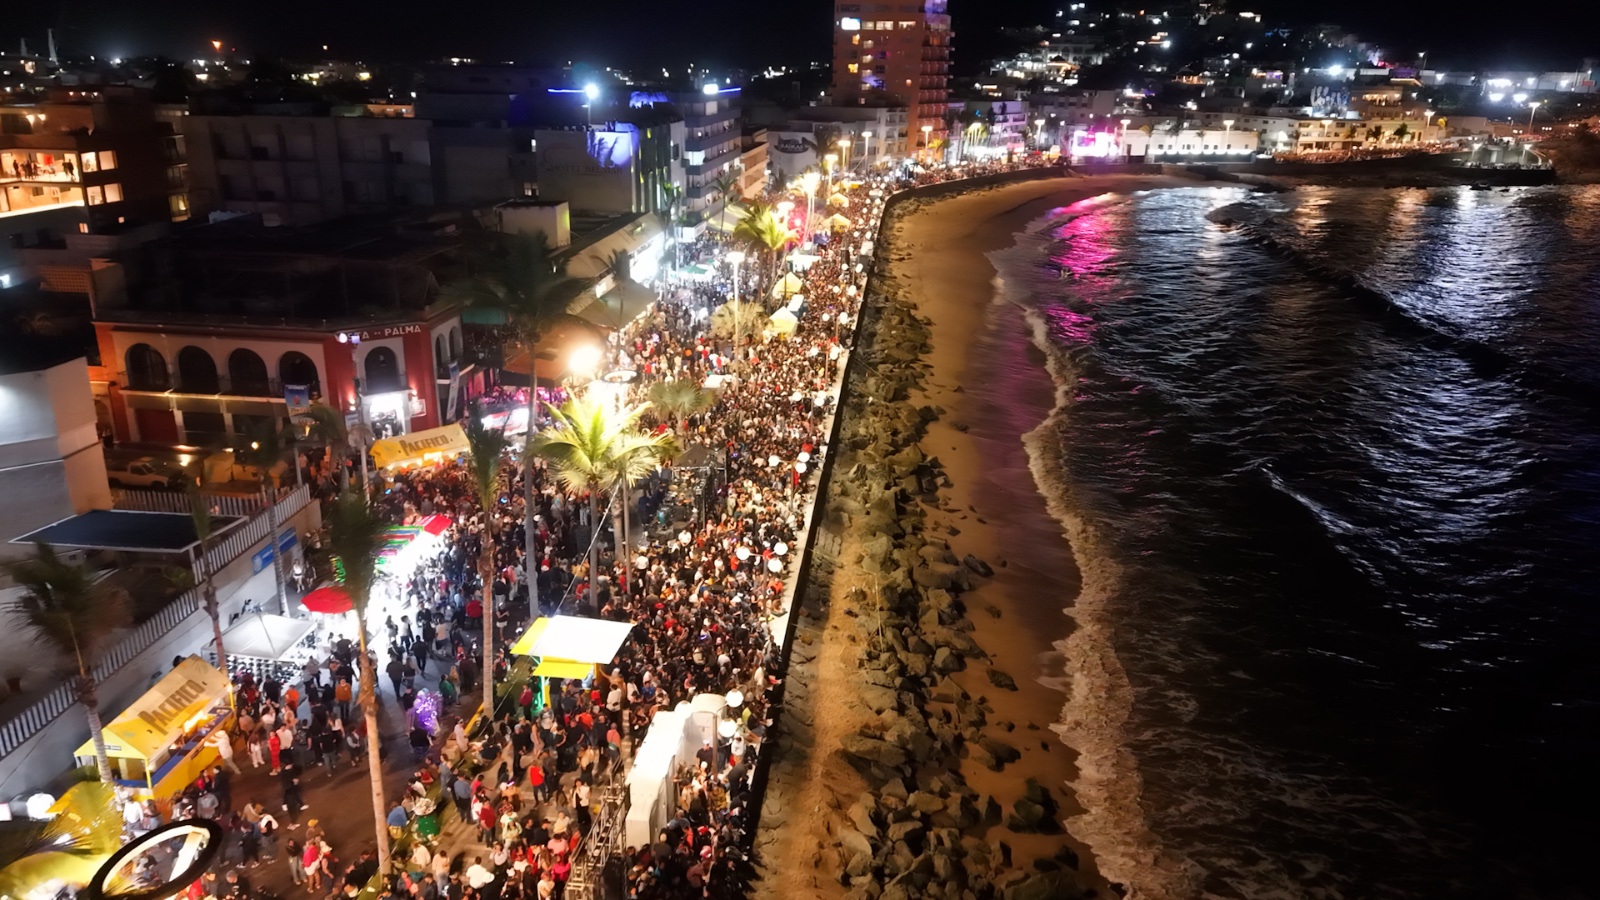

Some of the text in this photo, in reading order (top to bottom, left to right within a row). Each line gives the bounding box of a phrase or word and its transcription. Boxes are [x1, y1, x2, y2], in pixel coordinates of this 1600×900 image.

[384, 324, 421, 337] PALMA
[400, 435, 449, 456] PACIFICO
[138, 679, 206, 736] PACIFICO
